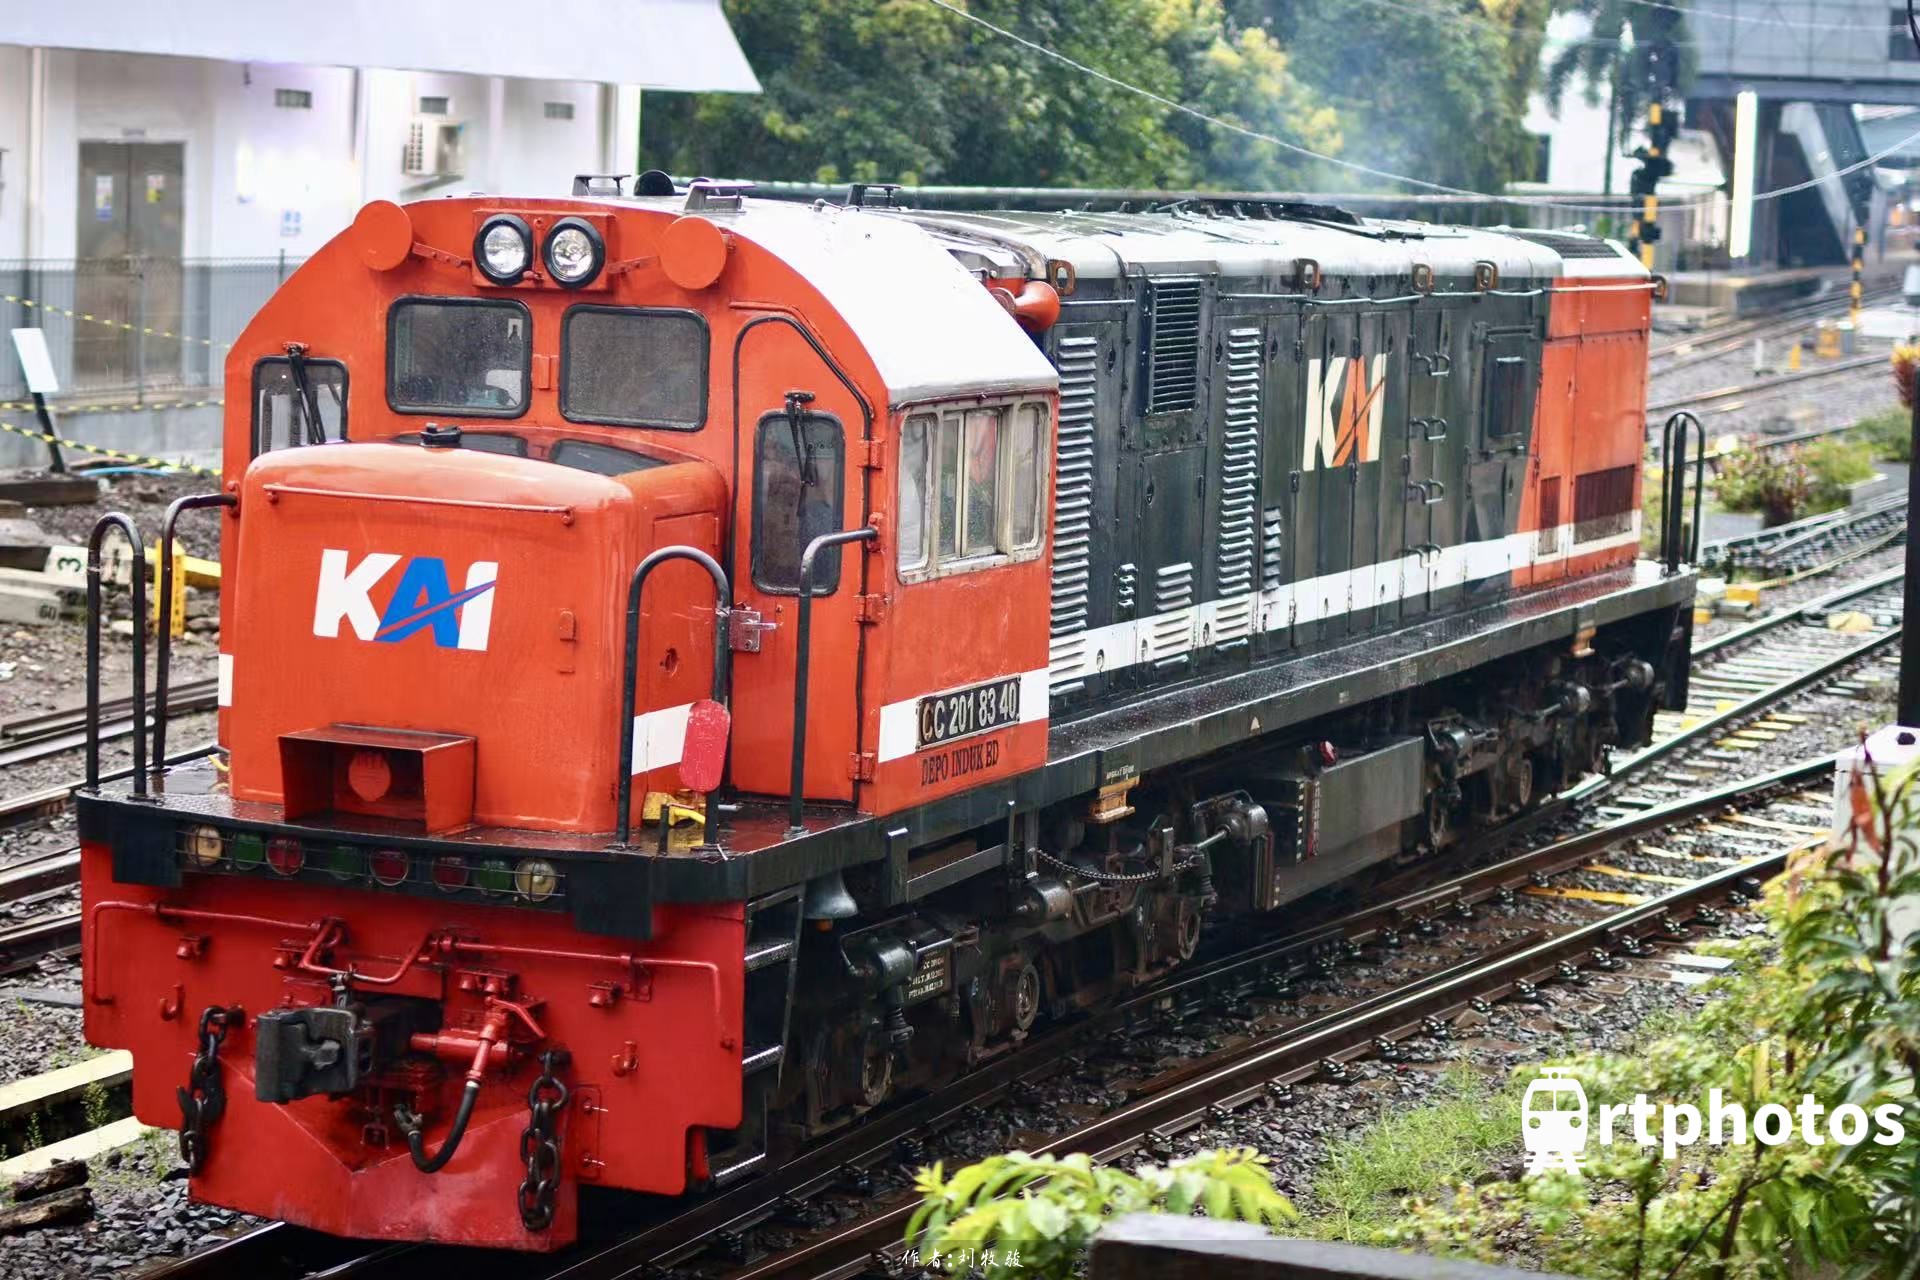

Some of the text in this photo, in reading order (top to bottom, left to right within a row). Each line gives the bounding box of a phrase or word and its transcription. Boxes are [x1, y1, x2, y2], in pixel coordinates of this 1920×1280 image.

[1303, 353, 1387, 471] KAI
[313, 549, 499, 651] KAI
[922, 682, 1017, 742] CC 201 83 40
[921, 739, 1000, 786] DEPO INDUK BD
